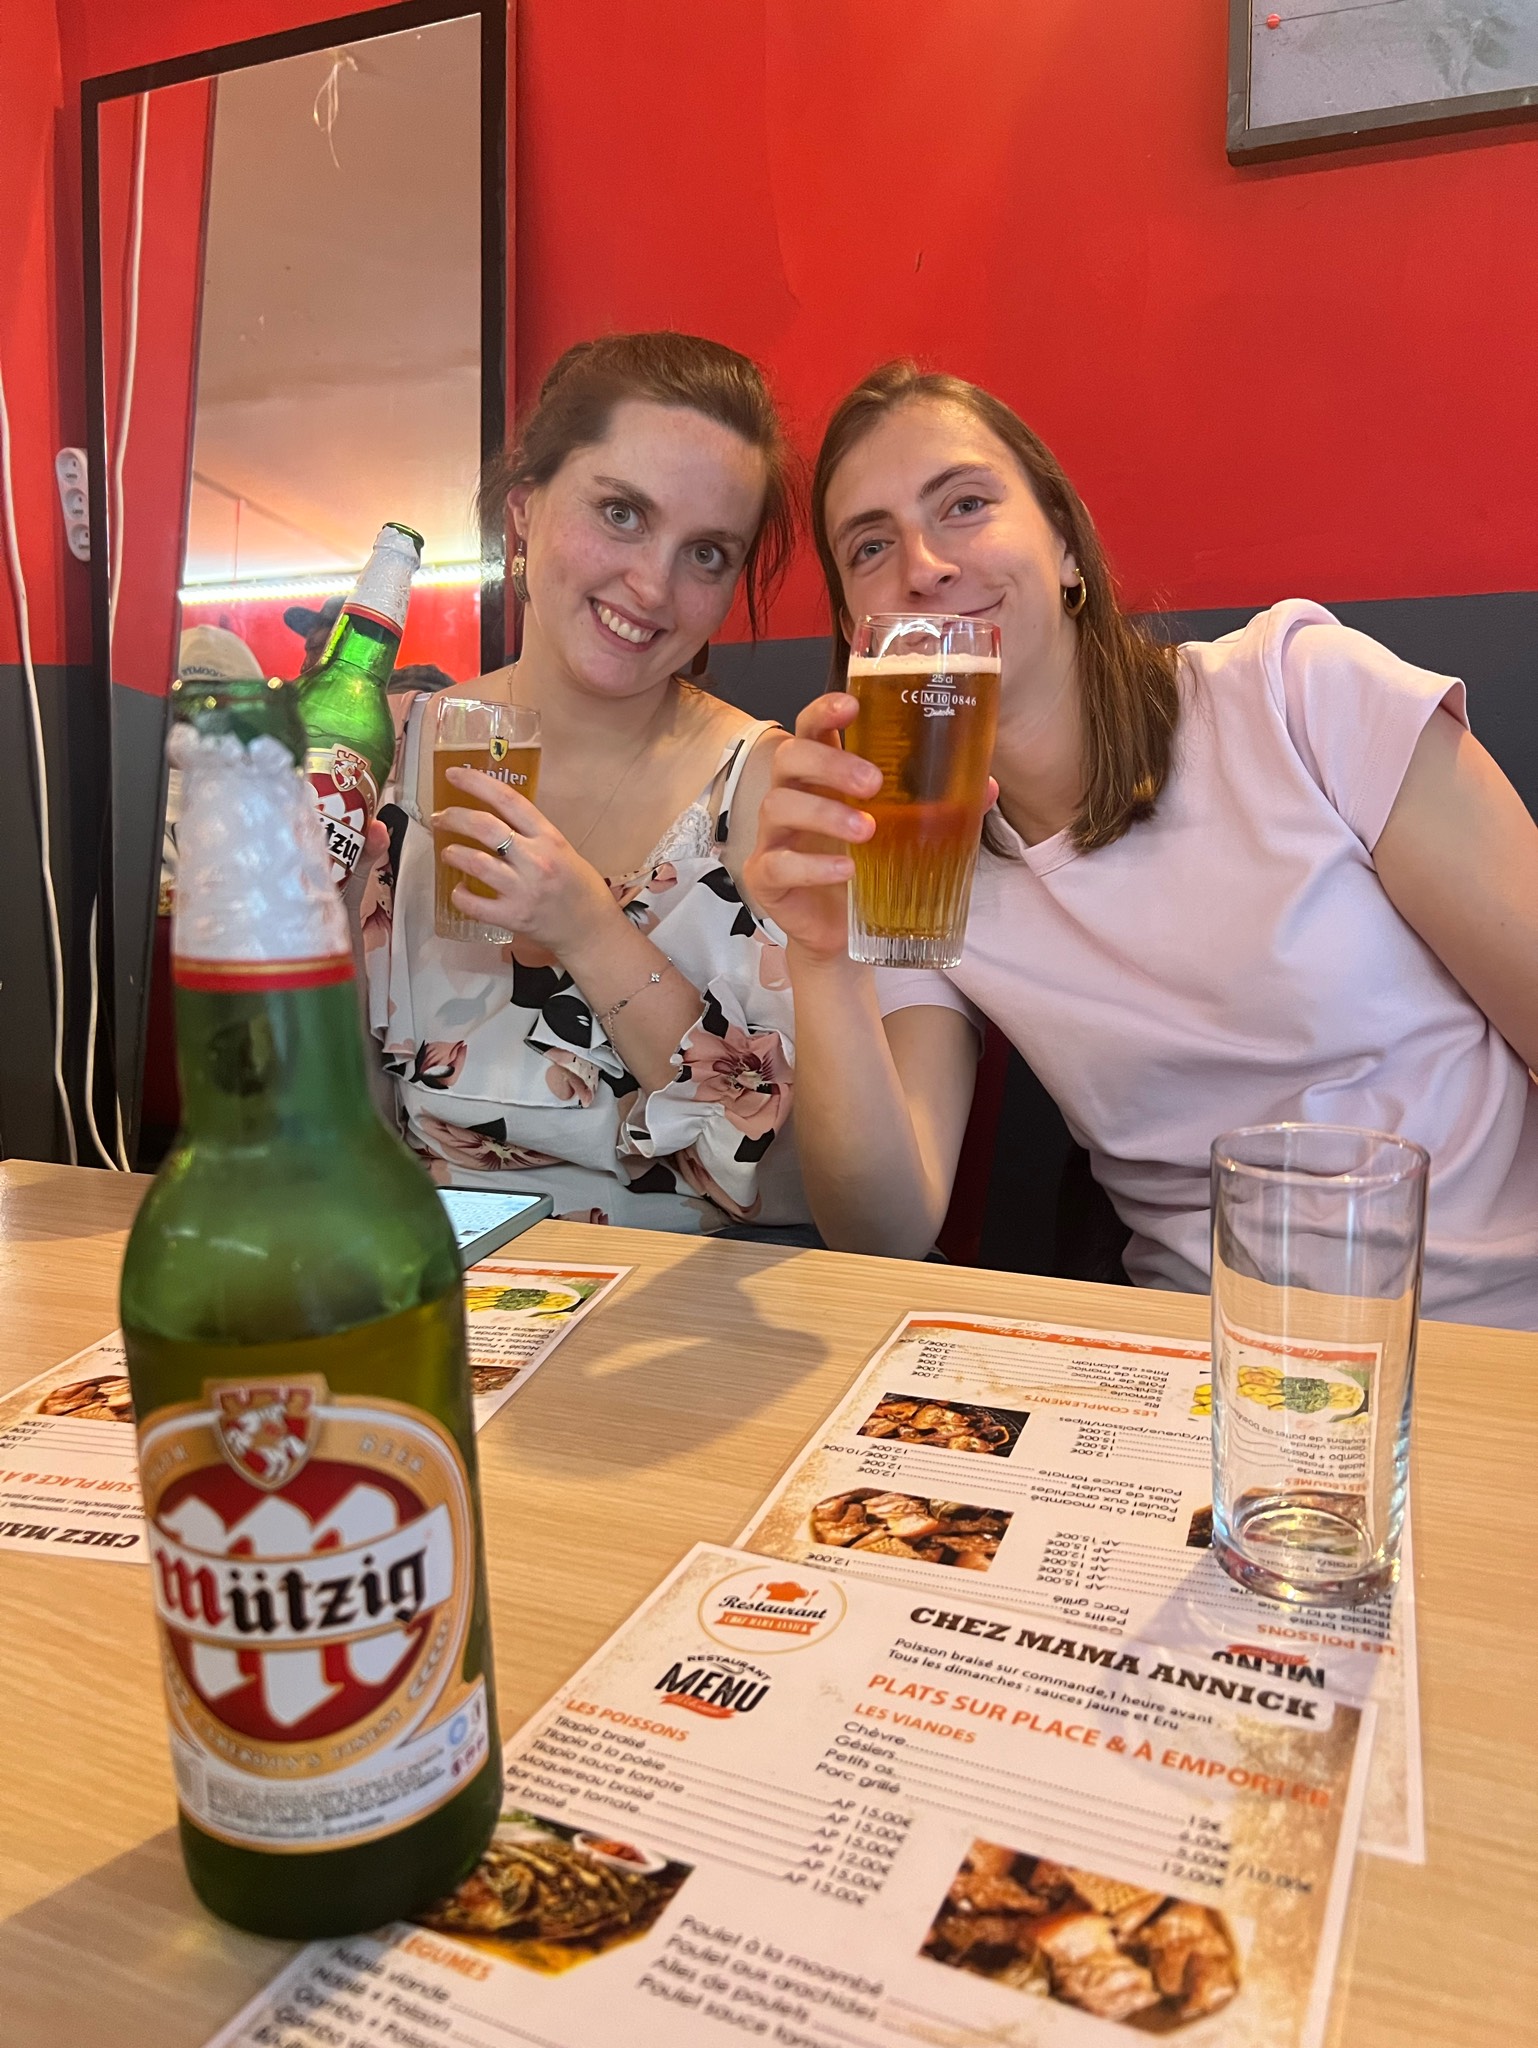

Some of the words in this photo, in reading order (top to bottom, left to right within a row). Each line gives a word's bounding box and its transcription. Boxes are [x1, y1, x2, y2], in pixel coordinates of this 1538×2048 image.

[931, 674, 944, 683] 25
[945, 675, 953, 684] cl
[952, 694, 977, 706] 0846
[1066, 1366, 1110, 1374] manioc
[1072, 1360, 1119, 1369] plantain
[1141, 1368, 1170, 1376] Frites
[1071, 1372, 1115, 1381] manioc
[1133, 1374, 1168, 1382] Bâton
[1138, 1380, 1166, 1389] Pâte
[1024, 1394, 1129, 1414] COMPLEMENTS
[1110, 1391, 1162, 1402] Semoule
[1133, 1409, 1158, 1418] LES
[1076, 1434, 1115, 1444] 15.00€
[1078, 1427, 1117, 1437] 12.00€
[822, 1444, 899, 1461] 5.00€/10.00€
[869, 1443, 908, 1455] 12.00€
[1070, 1447, 1109, 1458] 12.00€
[1074, 1441, 1113, 1451] 15.00€
[862, 1458, 902, 1470] 12.00€
[856, 1466, 896, 1478] 12.00€
[1038, 1469, 1088, 1482] tomate
[35, 1475, 100, 1489] PLACE
[95, 1480, 133, 1493] SUR
[1071, 1483, 1122, 1494] poulets
[1092, 1477, 1135, 1489] sauce
[1030, 1485, 1100, 1501] arachides
[1125, 1491, 1145, 1499] de
[1138, 1485, 1182, 1497] Poulet
[1031, 1494, 1096, 1509] moambé
[1103, 1496, 1129, 1505] aux
[1149, 1494, 1181, 1504] Ailes
[1133, 1502, 1178, 1514] Poulet
[1130, 1510, 1176, 1523] Poulet
[53, 1528, 140, 1549] CHEZ
[1055, 1531, 1096, 1543] 15.00€
[1046, 1539, 1088, 1551] 15.00€
[805, 1552, 850, 1567] 12.00€
[1044, 1548, 1085, 1559] 12.00€
[1042, 1556, 1084, 1568] 15.00€
[1038, 1565, 1080, 1577] 15.00€
[1036, 1574, 1079, 1587] 15.00€
[718, 1594, 828, 1619] Restaurant
[1053, 1595, 1090, 1607] grillé
[1094, 1602, 1130, 1615] Porc
[1085, 1611, 1127, 1626] Petits
[1289, 1616, 1336, 1631] braisé
[1256, 1623, 1357, 1650] POISSONS
[1341, 1625, 1392, 1640] Tilapia
[1361, 1640, 1396, 1656] LES
[686, 1654, 773, 1682] RESTAURANT
[910, 1606, 1012, 1643] CHEZ
[1014, 1628, 1141, 1676] MAMA
[1148, 1662, 1319, 1722] ANNICK
[1212, 1650, 1325, 1690] MENU
[654, 1662, 771, 1713] MENU
[894, 1638, 949, 1659] Poisson
[951, 1649, 994, 1670] braisé
[996, 1664, 1020, 1677] sur
[1121, 1691, 1167, 1714] heure
[1170, 1706, 1214, 1726] avant
[888, 1649, 919, 1667] Tous
[922, 1657, 942, 1671] les
[944, 1663, 1024, 1691] dimanches
[1034, 1686, 1083, 1707] sauces
[1084, 1697, 1130, 1718] jaune
[1133, 1709, 1150, 1723] et
[1153, 1716, 1180, 1732] Eru
[565, 1699, 600, 1717] LES
[598, 1706, 691, 1743] POISSONS
[853, 1702, 888, 1721] LES
[892, 1712, 978, 1745] VIANDES
[555, 1715, 601, 1737] Tilapia
[601, 1729, 647, 1750] braisé
[844, 1721, 907, 1746] Chèvre
[543, 1727, 589, 1748] Tilapia
[604, 1745, 620, 1758] la
[835, 1735, 896, 1760] Gésiers
[867, 1674, 950, 1706] PLATS
[950, 1695, 1009, 1723] SUR
[1010, 1710, 1103, 1747] PLACE
[1105, 1735, 1128, 1755] &
[1133, 1739, 1154, 1763] À
[1160, 1749, 1331, 1810] EMPORTER
[825, 1748, 870, 1769] Petits
[531, 1739, 578, 1761] Tilapia
[579, 1756, 625, 1776] sauce
[628, 1767, 686, 1794] tomate
[519, 1752, 607, 1787] Maquereau
[608, 1780, 656, 1801] braisé
[816, 1761, 856, 1781] Porc
[858, 1776, 901, 1794] grillé
[521, 1786, 567, 1810] braisé
[583, 1788, 641, 1814] tomate
[832, 1798, 856, 1810] AP
[861, 1804, 914, 1828] 15.00€
[825, 1812, 850, 1824] AP
[854, 1818, 907, 1844] 15.00€
[816, 1826, 840, 1838] AP
[844, 1833, 899, 1859] 15.00€
[808, 1842, 833, 1855] AP
[837, 1849, 893, 1876] 12.00€
[800, 1857, 825, 1870] AP
[829, 1864, 885, 1892] 15.00€
[783, 1871, 808, 1885] AP
[813, 1878, 869, 1907] 15.00€
[679, 1913, 743, 1948] Poulet
[762, 1943, 785, 1964] la
[785, 1953, 885, 1999] moambé
[665, 1932, 731, 1968] Poulet
[730, 1957, 770, 1983] aux
[771, 1974, 878, 2022] arachides
[651, 1954, 699, 1983] Ailes
[700, 1973, 731, 1994] de
[731, 1984, 810, 2026] poulets
[635, 1972, 704, 2008] Poulet
[704, 2000, 770, 2036] sauce
